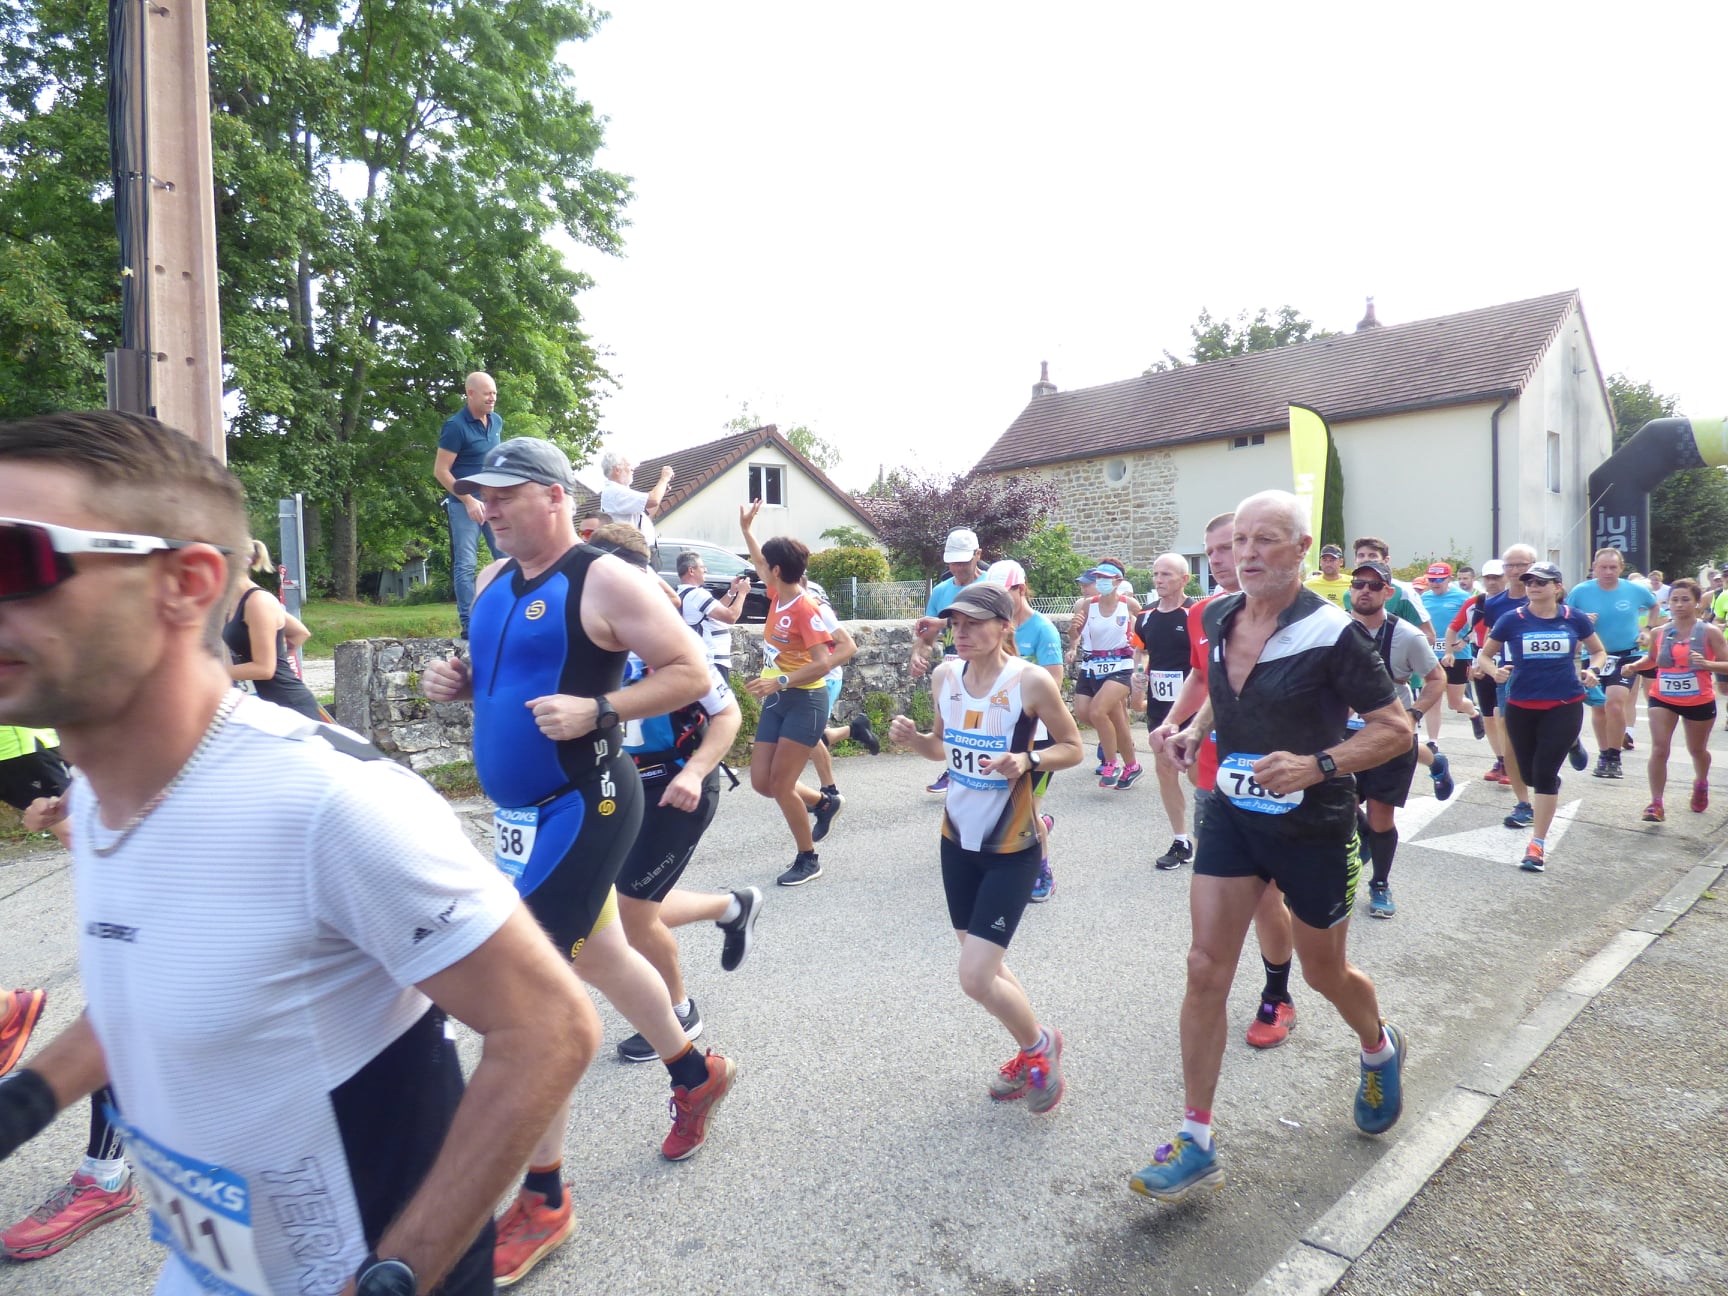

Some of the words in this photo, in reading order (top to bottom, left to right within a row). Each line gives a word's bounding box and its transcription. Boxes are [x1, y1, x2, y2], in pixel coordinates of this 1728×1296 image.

[1530, 640, 1561, 652] 830
[1096, 663, 1117, 674] 787
[1154, 680, 1173, 697] 181
[1664, 680, 1691, 690] 795
[955, 734, 1004, 749] BROOKS
[631, 852, 675, 892] Kalenji
